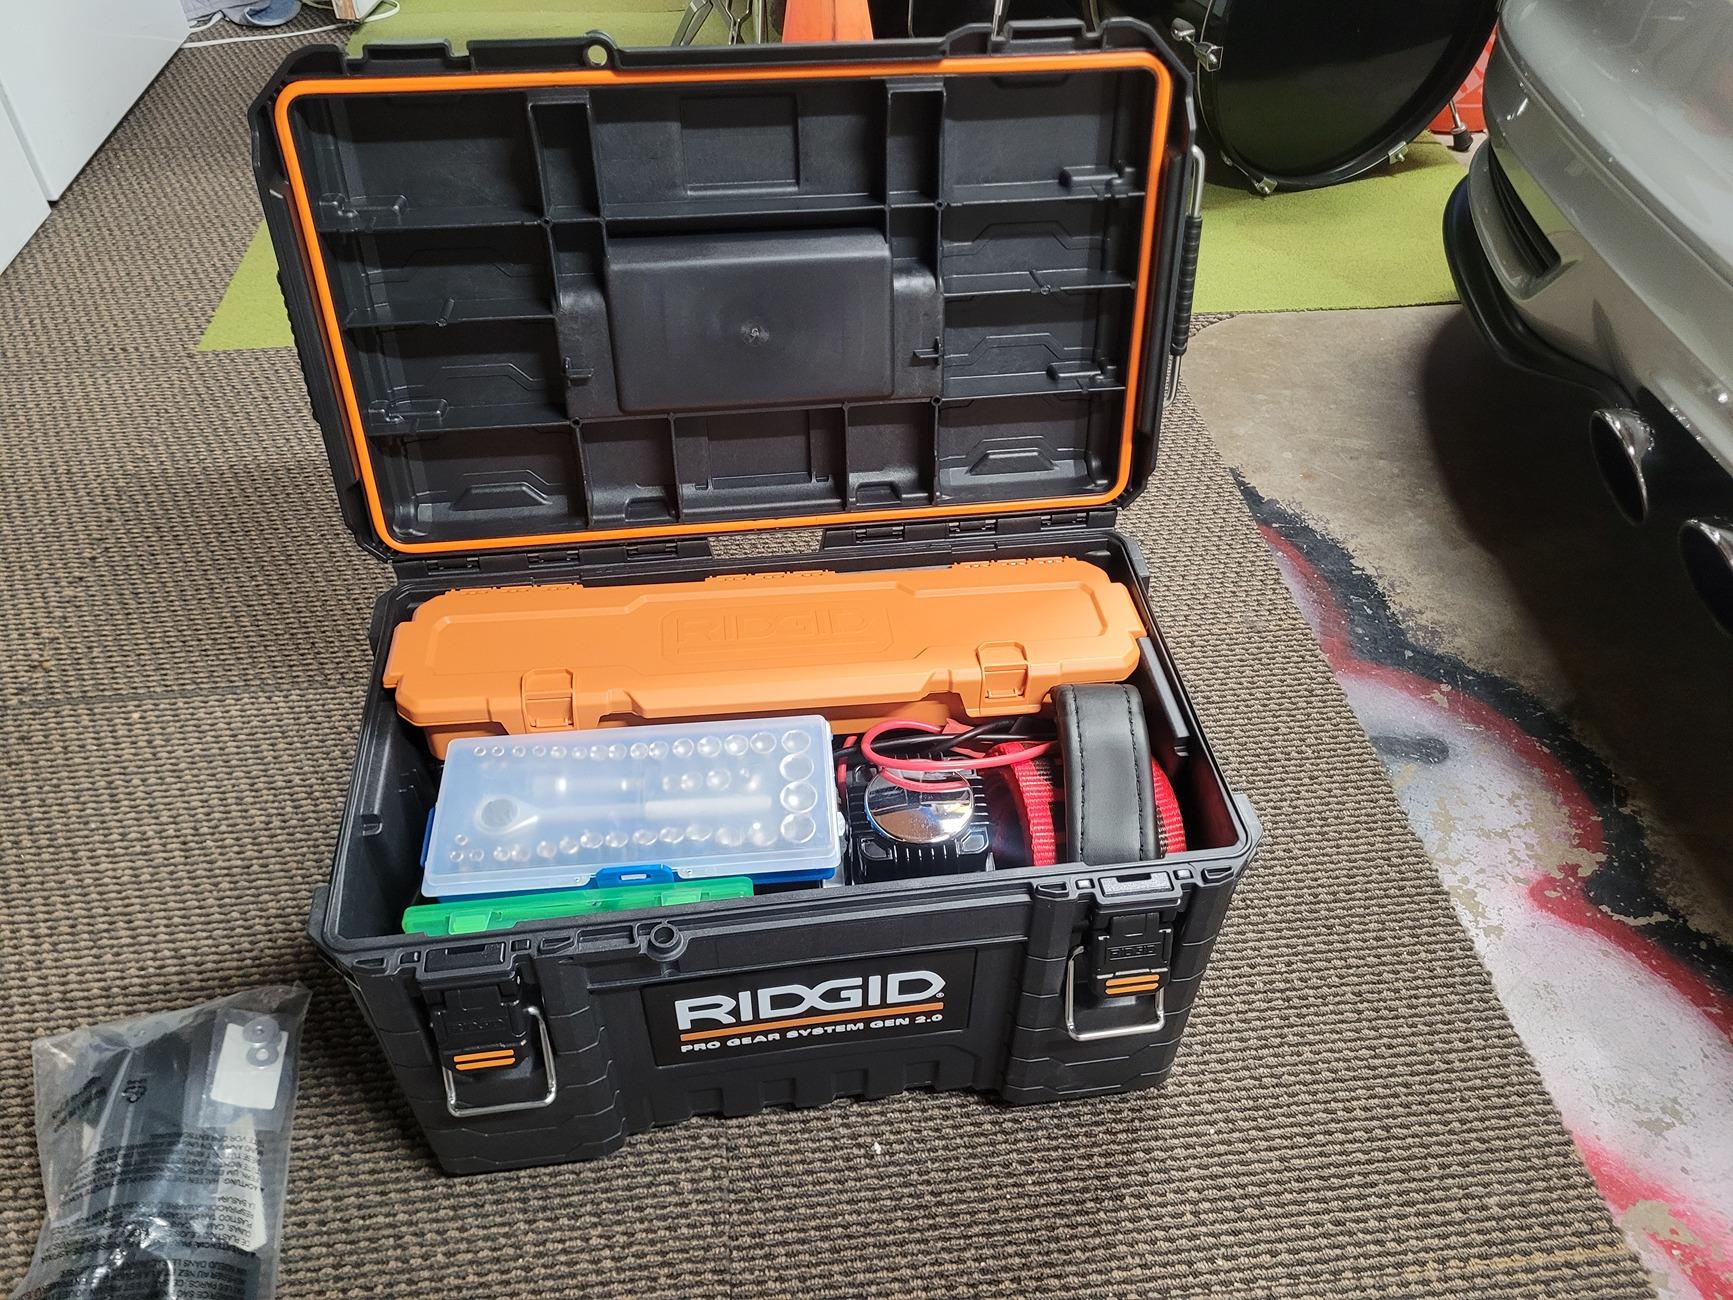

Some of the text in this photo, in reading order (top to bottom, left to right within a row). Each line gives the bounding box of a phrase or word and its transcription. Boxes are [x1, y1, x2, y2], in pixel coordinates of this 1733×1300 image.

[675, 970, 946, 1031] RIDGID
[680, 1013, 943, 1053] PRO GEAR SYSTEM GEN 2.0
